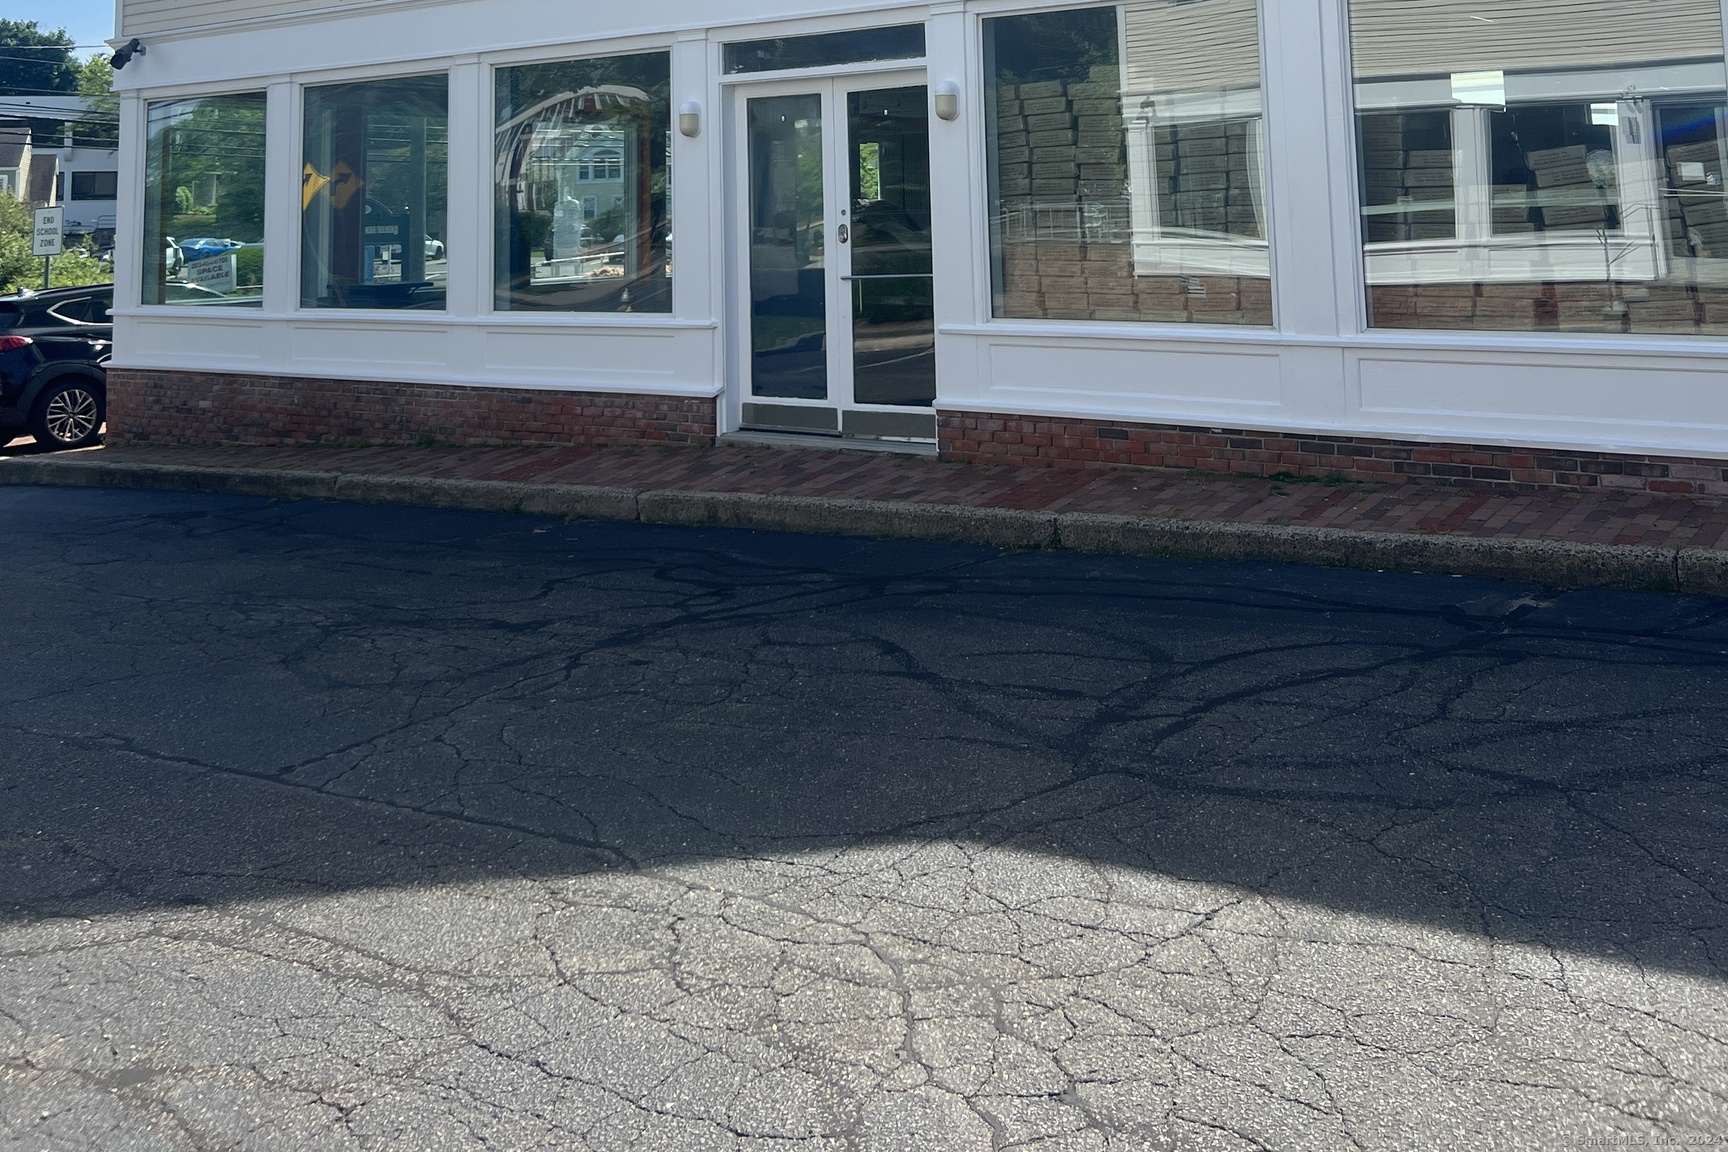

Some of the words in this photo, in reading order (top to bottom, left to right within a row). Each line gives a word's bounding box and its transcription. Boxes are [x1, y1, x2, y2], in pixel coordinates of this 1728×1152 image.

[43, 216, 55, 225] END
[36, 227, 59, 236] SCHOOL
[39, 238, 55, 247] ZONE
[196, 264, 224, 276] SPACE
[191, 270, 230, 283] AVAILABLE
